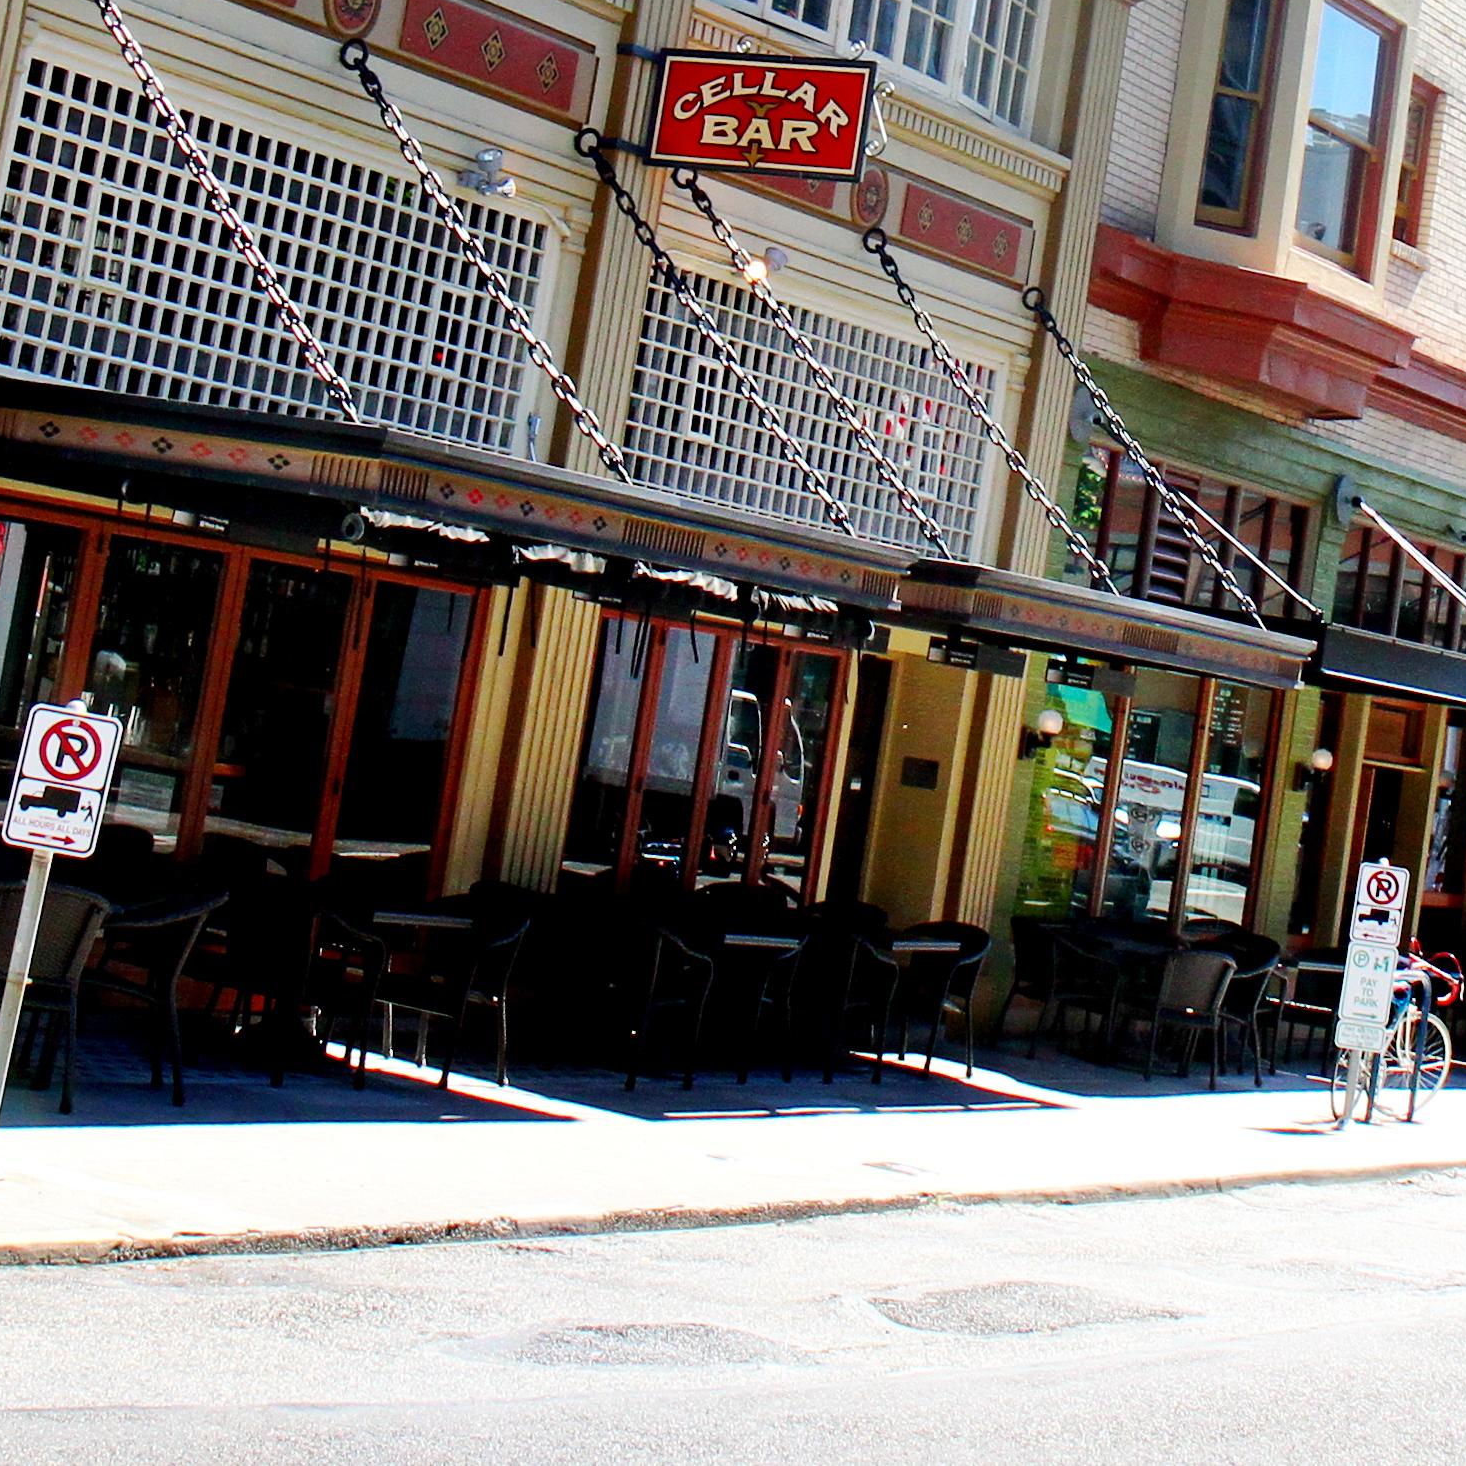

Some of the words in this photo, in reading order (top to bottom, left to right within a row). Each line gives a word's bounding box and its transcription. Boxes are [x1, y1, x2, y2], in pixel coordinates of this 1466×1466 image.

[673, 70, 849, 138] CELLAR
[700, 114, 819, 153] BAR
[1359, 976, 1377, 987] PAY
[1362, 987, 1374, 997] TO
[1354, 996, 1378, 1007] PARK
